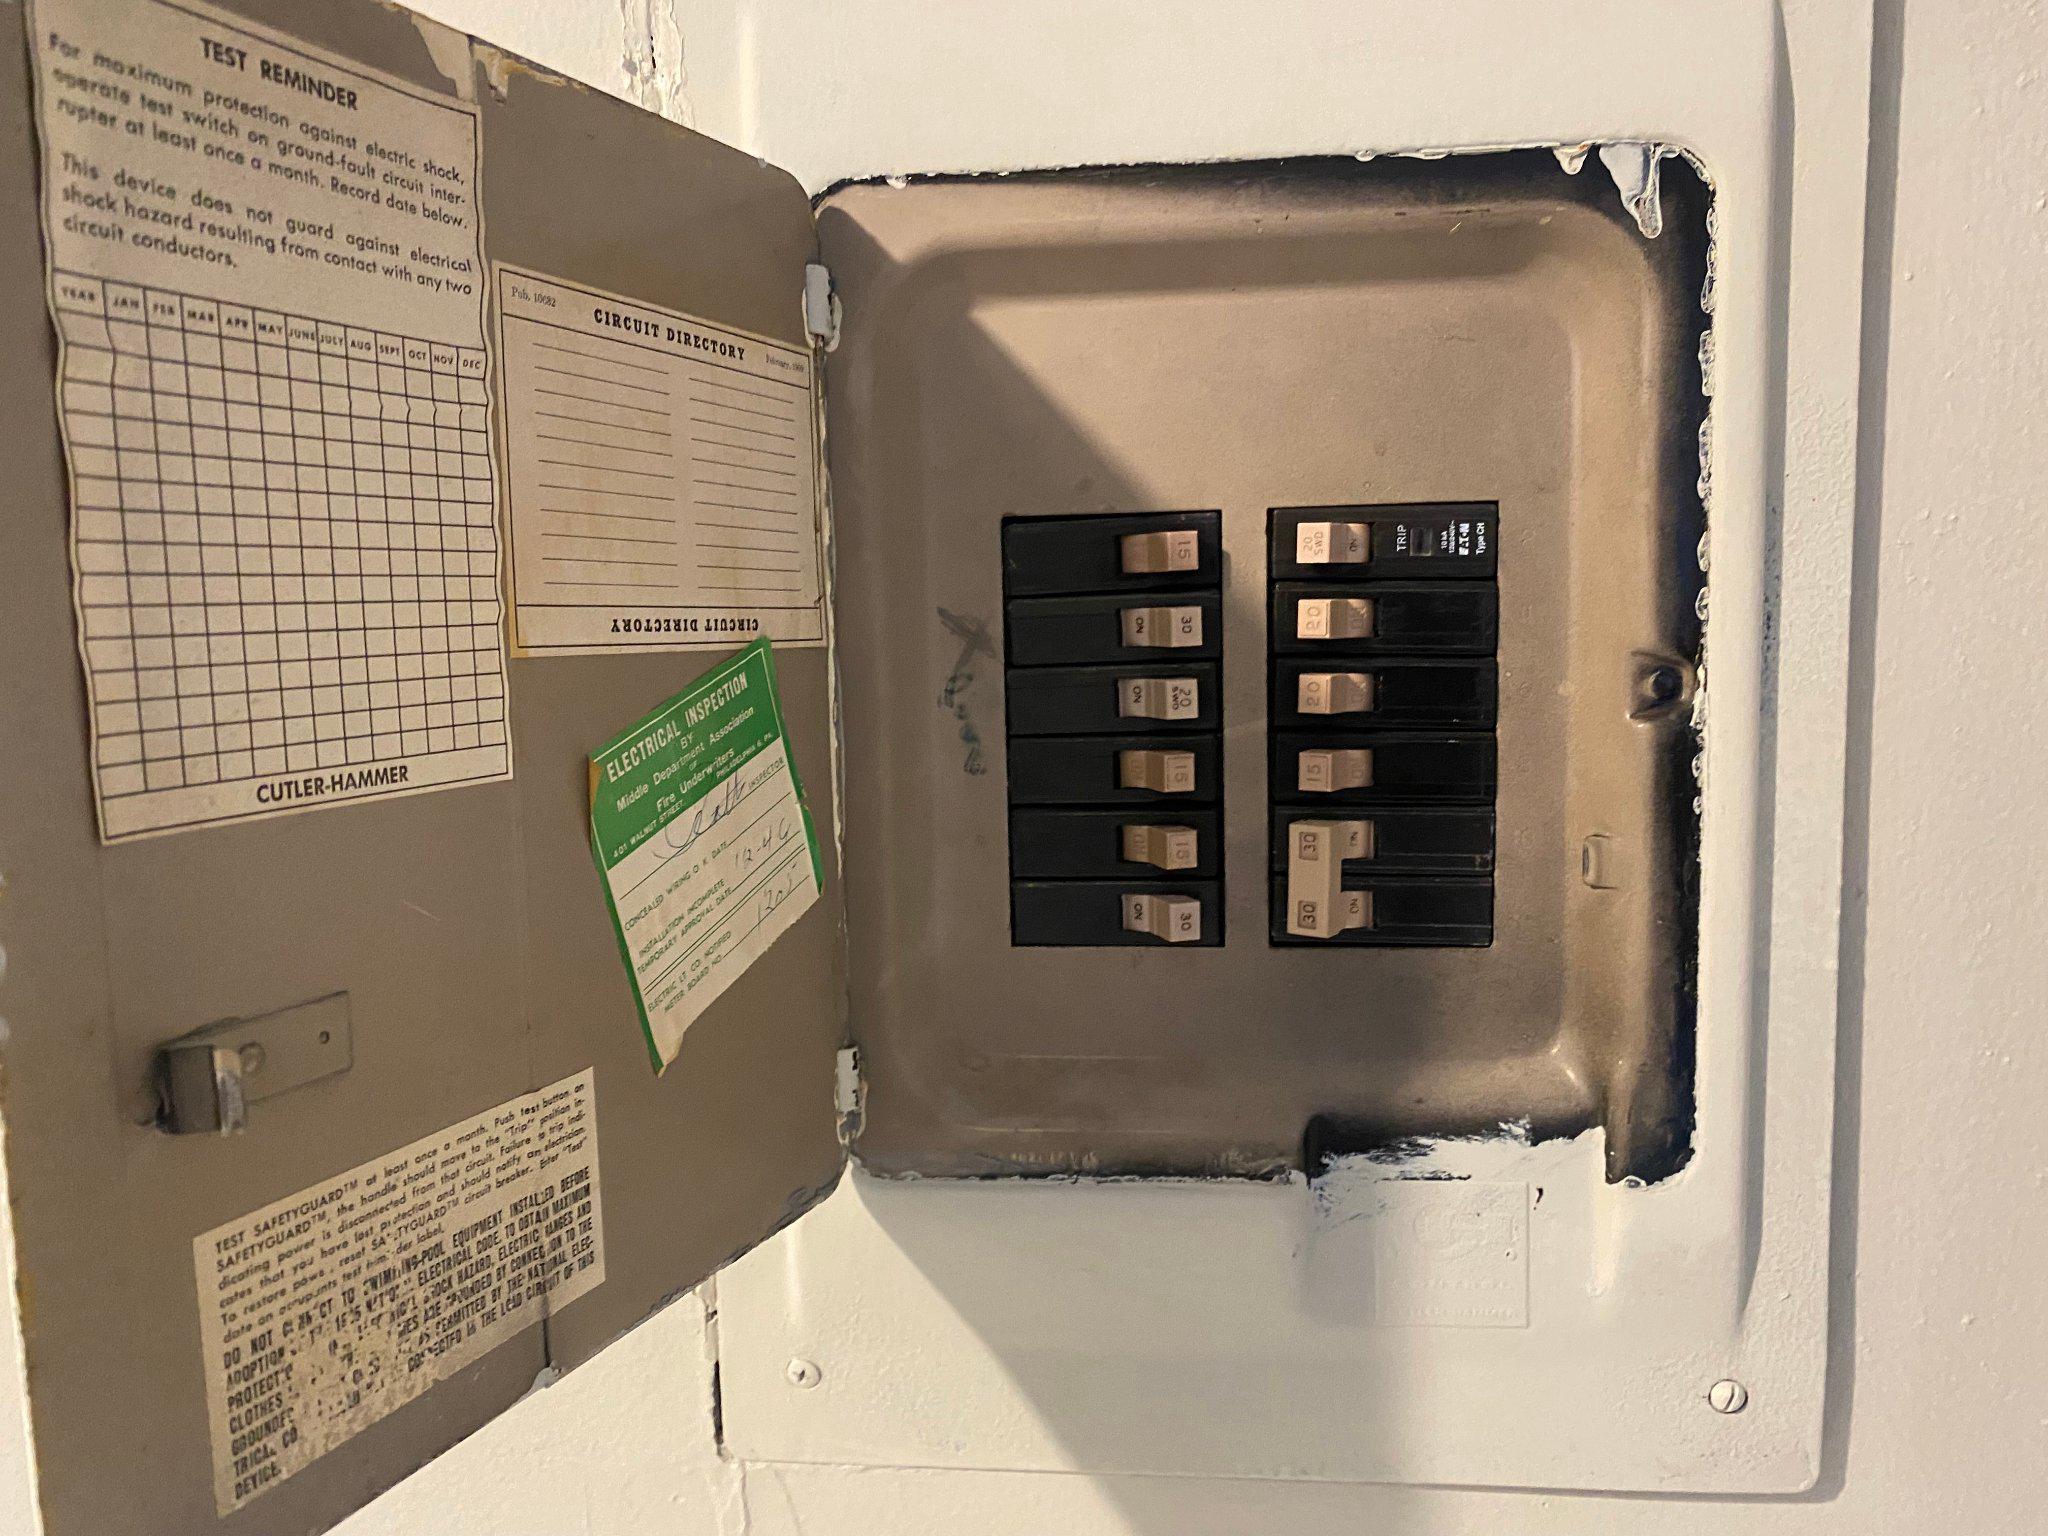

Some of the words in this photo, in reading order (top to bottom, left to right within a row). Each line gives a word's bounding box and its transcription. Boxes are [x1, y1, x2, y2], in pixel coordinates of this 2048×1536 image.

[200, 37, 246, 71] TEST
[260, 59, 356, 109] REMINDER
[49, 32, 80, 57] For
[93, 53, 192, 95] maximum
[203, 90, 289, 127] protection
[299, 122, 356, 149] against
[365, 141, 415, 169] electric
[423, 159, 464, 185] shock,
[53, 68, 130, 104] operate
[140, 93, 172, 115] test
[182, 110, 238, 136] switch
[247, 130, 268, 146] on
[277, 140, 375, 178] ground-fault
[382, 170, 423, 193] circuit
[430, 183, 465, 204] inter-
[57, 98, 116, 127] rupter
[125, 119, 144, 135] at
[152, 121, 196, 150] least
[203, 143, 244, 164] once
[250, 157, 261, 170] a
[268, 162, 323, 187] month.
[330, 176, 380, 204] Record
[385, 192, 416, 214] date
[421, 202, 466, 228] below.
[62, 152, 99, 180] This
[113, 168, 176, 199] device
[190, 189, 232, 214] does
[246, 207, 272, 224] not
[285, 218, 333, 239] guard
[345, 234, 399, 255] against
[410, 246, 471, 272] electrical
[63, 184, 116, 212] shock
[123, 196, 193, 230] hazard
[199, 221, 275, 253] resulting
[280, 236, 318, 259] from
[324, 252, 376, 273] contact
[381, 264, 411, 281] with
[416, 274, 441, 292] any
[445, 278, 471, 295] two
[63, 215, 124, 241] circuit
[131, 233, 236, 267] conductors.
[187, 310, 214, 322] MAR
[226, 317, 248, 329] APR
[258, 323, 284, 336] MAY
[288, 328, 315, 341] JUNE
[319, 334, 344, 347] JULY
[351, 339, 372, 351] AUG
[379, 344, 400, 356] SEPT
[409, 351, 427, 361] OCT
[433, 355, 453, 365] NOV
[463, 359, 481, 369] DEC
[594, 308, 659, 338] CIRCUIT
[666, 327, 746, 361] DIRECTORY
[1178, 541, 1191, 560] 15
[1303, 536, 1313, 552] 20
[1397, 525, 1407, 552] TRIP
[1476, 538, 1486, 555] Type
[611, 618, 699, 633] DIRECTORY
[705, 618, 759, 632] CIRCUIT
[1135, 617, 1144, 634] ON
[1181, 616, 1192, 634] 30
[1306, 606, 1320, 631] 20
[1133, 686, 1142, 703] ON
[1180, 688, 1191, 707] 20
[1306, 682, 1320, 706] 20
[606, 721, 680, 781] ELECTRICAL
[685, 672, 747, 726] INSPECTION
[680, 731, 693, 749] BY
[616, 783, 648, 811] Middle
[652, 742, 704, 785] Department
[709, 707, 753, 744] Association
[656, 793, 675, 811] Fire
[679, 748, 734, 793] Underwriters
[748, 756, 783, 789] INSPECTOR
[1174, 765, 1187, 783] 15
[1306, 764, 1321, 782] 15
[256, 766, 409, 803] CUTLER-HAMMER
[613, 842, 627, 857] 401
[629, 819, 656, 844] WALNUT
[658, 799, 682, 823] STREET
[1304, 834, 1316, 853] 30
[624, 894, 663, 931] CONCEALED
[665, 870, 691, 894] WIRING
[711, 840, 728, 859] DATE
[637, 935, 676, 974] TEMPORARY
[680, 904, 713, 937] APPROVAL
[715, 886, 733, 905] DATE
[638, 913, 684, 957] INSTALLATION
[687, 878, 724, 914] INCOMPLETE
[1134, 902, 1143, 922] ON
[1180, 912, 1192, 931] 30
[1303, 904, 1315, 923] 30
[647, 980, 676, 1012] ELECTRIC
[704, 930, 731, 958] NOTIFIED
[664, 989, 684, 1012] METER
[686, 965, 709, 991] BOARD
[215, 1230, 244, 1253] TEST
[365, 1174, 377, 1186] at
[383, 1160, 408, 1177] least
[414, 1148, 437, 1164] once
[443, 1142, 450, 1151] a
[494, 1111, 514, 1127] Push
[520, 1103, 539, 1115] test
[336, 1203, 354, 1216] the
[360, 1181, 397, 1205] handle
[402, 1161, 435, 1186] should
[440, 1151, 466, 1168] move
[470, 1144, 480, 1153] to
[485, 1135, 500, 1147] the
[218, 1260, 270, 1290] dicating
[277, 1238, 315, 1265] power
[321, 1230, 331, 1240] is
[411, 1181, 435, 1197] from
[440, 1168, 459, 1184] that
[499, 1137, 531, 1156] Failure
[320, 1240, 348, 1258] have
[354, 1225, 373, 1243] lost
[436, 1183, 455, 1202] and
[460, 1167, 490, 1190] should
[220, 1312, 237, 1325] To
[243, 1287, 286, 1314] restore
[338, 1246, 365, 1266] reset
[464, 1183, 491, 1204] circuit
[495, 1166, 533, 1188] breaker.
[498, 1228, 539, 1261] ELECTRIC
[223, 1346, 241, 1369] DO
[250, 1329, 272, 1354] NOT
[341, 1286, 355, 1306] TO
[560, 1165, 589, 1192] BEFORE
[506, 1272, 524, 1294] THE
[223, 1323, 252, 1343] date
[229, 1391, 282, 1434] CLOTHES
